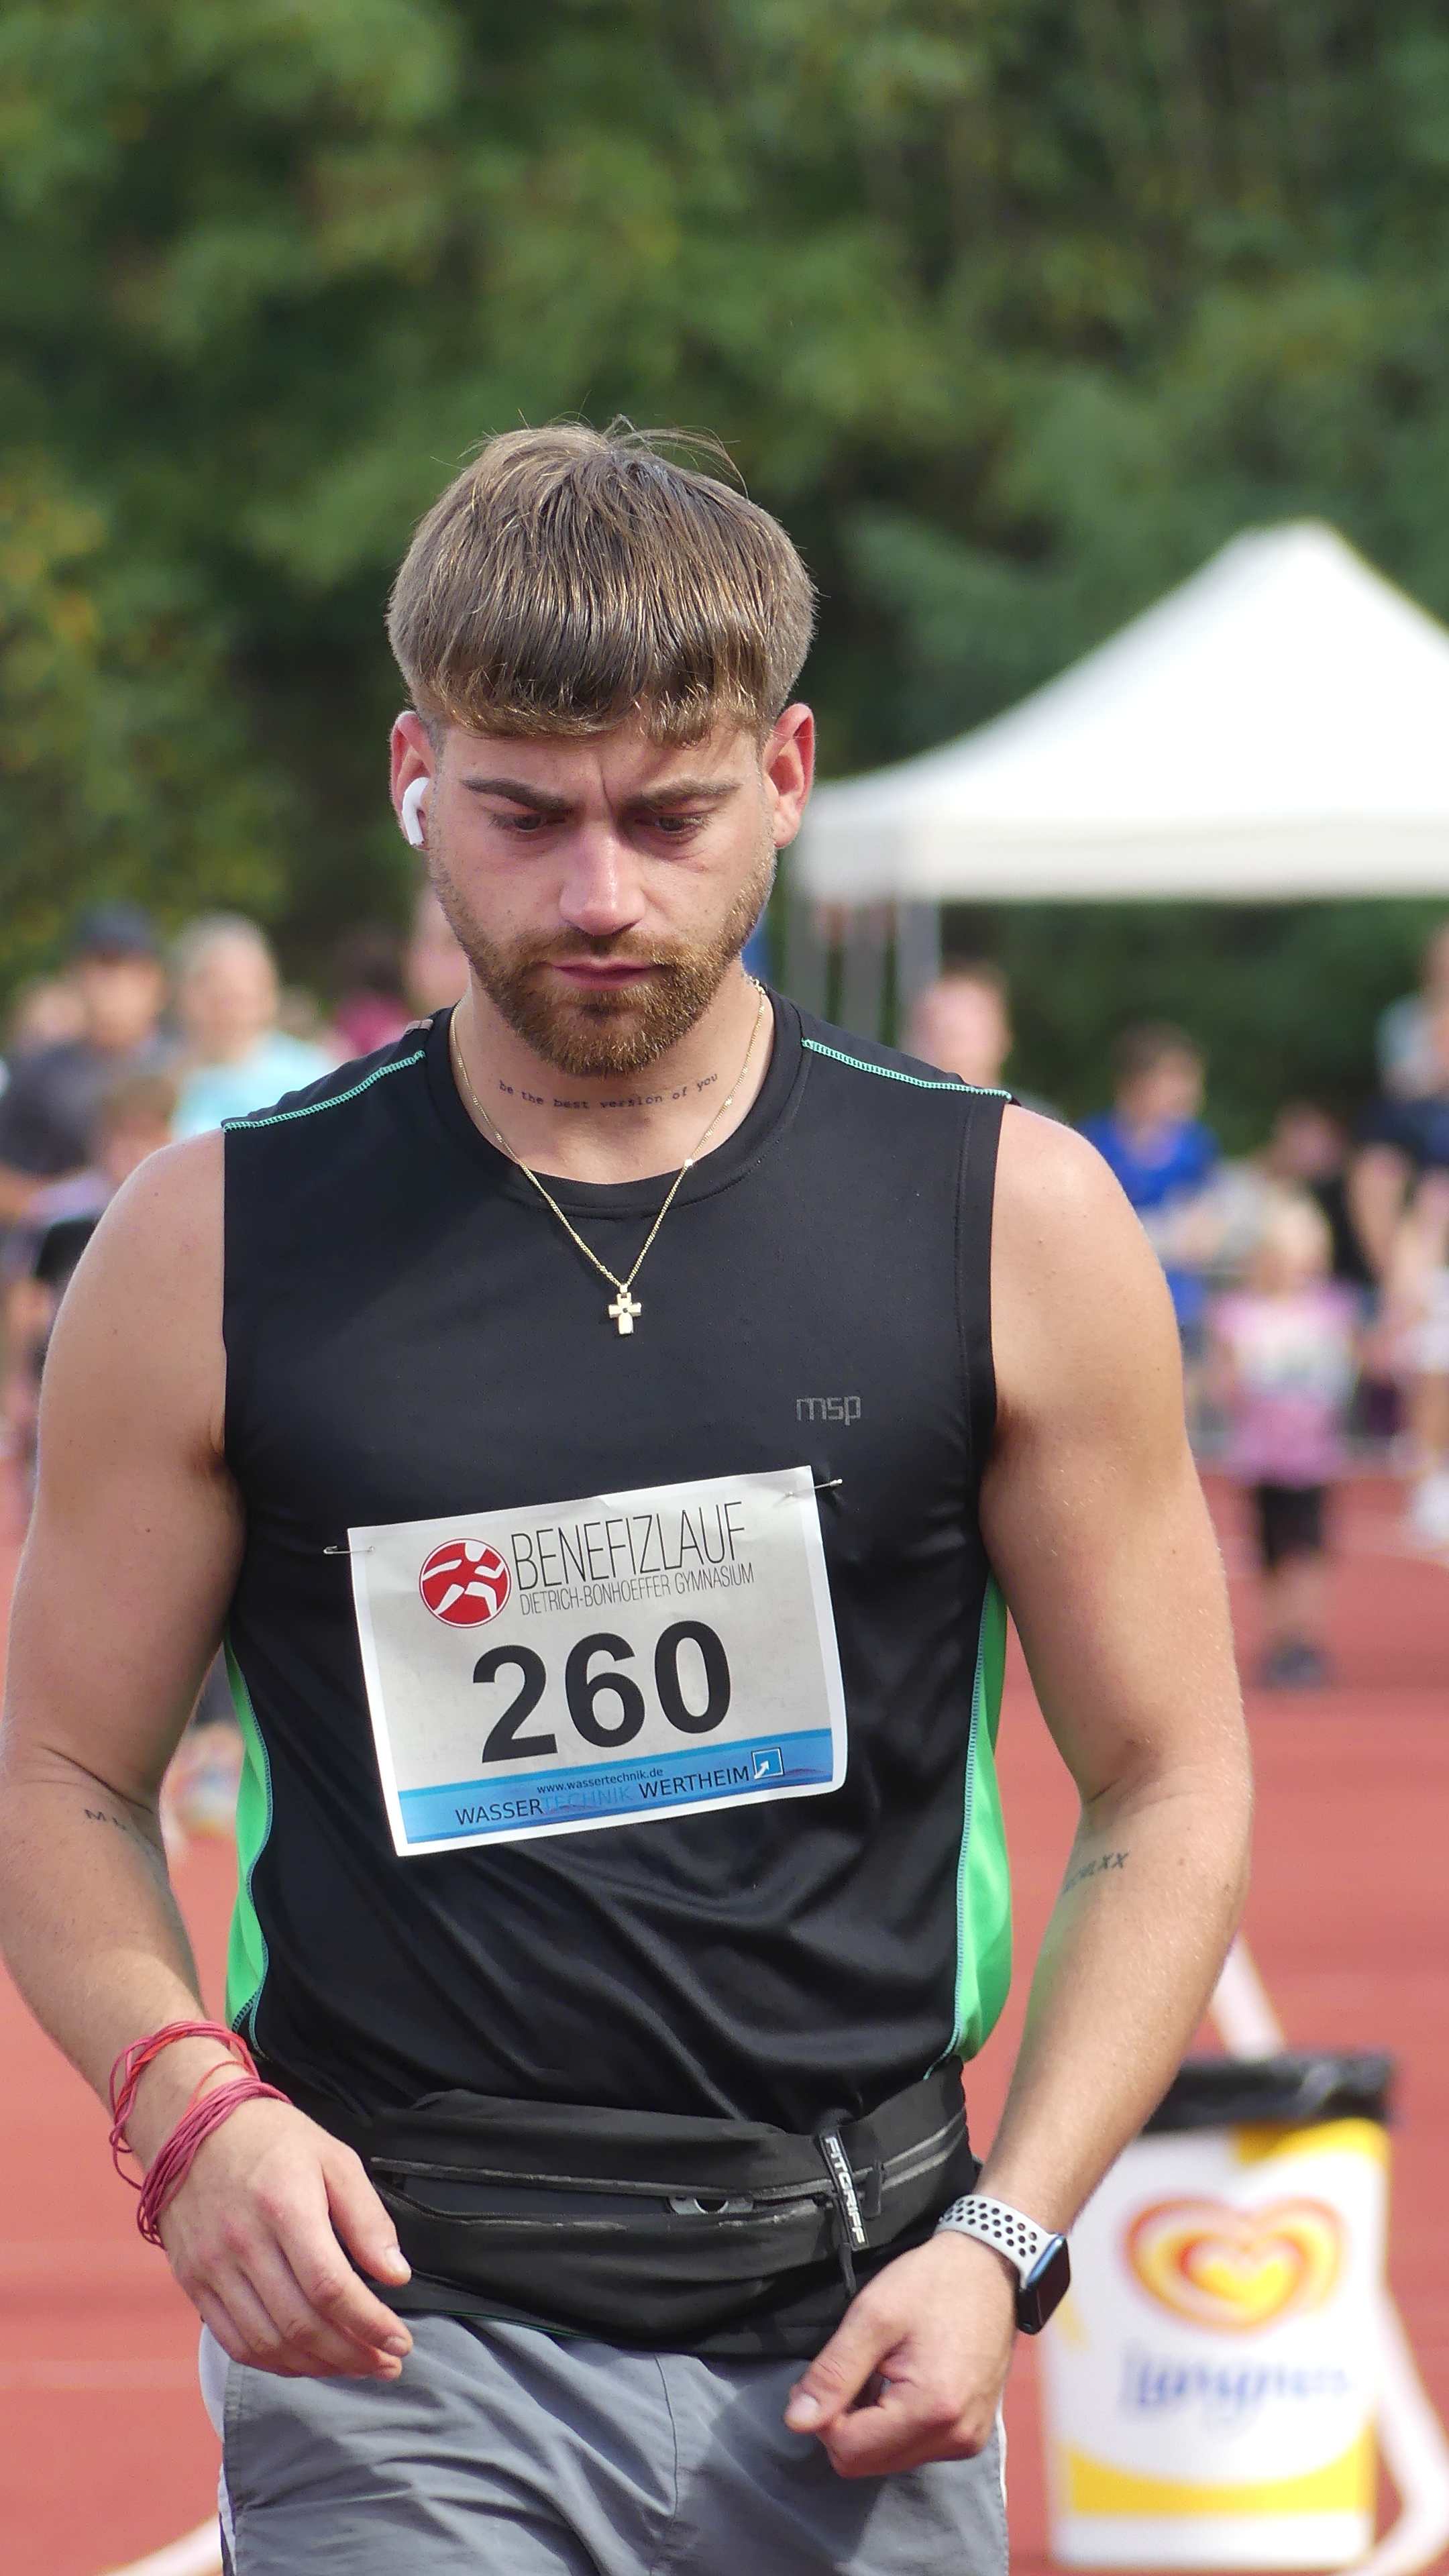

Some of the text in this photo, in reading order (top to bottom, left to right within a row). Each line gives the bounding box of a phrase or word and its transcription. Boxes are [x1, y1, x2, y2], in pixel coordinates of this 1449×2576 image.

[498, 1073, 718, 1109] be the best version of you
[796, 1396, 861, 1426] msp
[511, 1501, 745, 1591] BENEFIZLAUF
[519, 1562, 755, 1615] DIETRICH-BONHOEFFER GYMNASIUM
[472, 1619, 731, 1764] 260
[537, 1767, 664, 1794] www.wassertechnik.de
[639, 1765, 751, 1799] WERTHEIM
